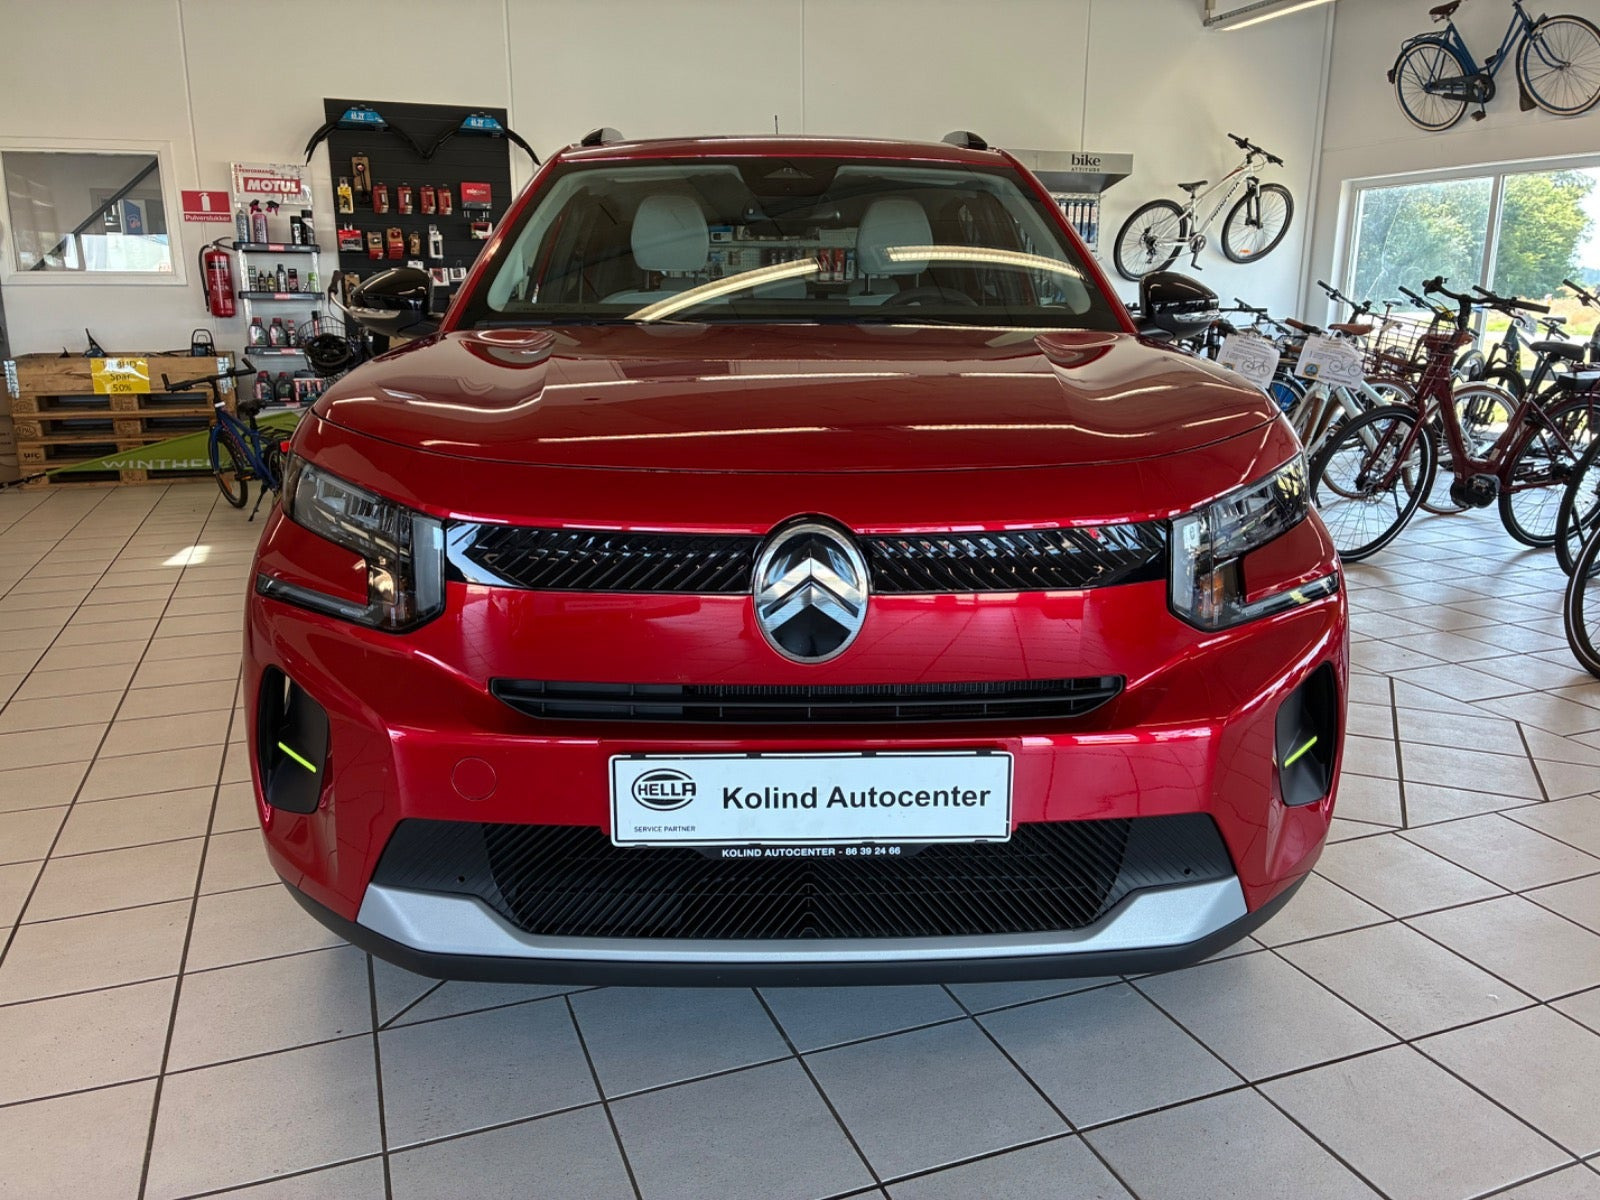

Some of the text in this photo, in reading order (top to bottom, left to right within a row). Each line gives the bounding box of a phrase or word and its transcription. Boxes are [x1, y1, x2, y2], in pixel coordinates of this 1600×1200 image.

[1071, 153, 1101, 166] bike
[247, 179, 299, 193] MOTUL
[185, 214, 231, 222] Pulverslukker
[101, 360, 137, 370] TBUD
[110, 373, 130, 382] Spar
[112, 383, 132, 392] 50%
[638, 782, 697, 797] HELLA
[722, 785, 991, 809] Kolind Autocenter
[634, 825, 696, 833] SERVICE PARTNER
[722, 848, 762, 858] KOLIND
[764, 847, 836, 857] AUTOCENTER
[860, 847, 872, 856] 39
[874, 847, 886, 855] 24
[888, 846, 901, 855] 66
